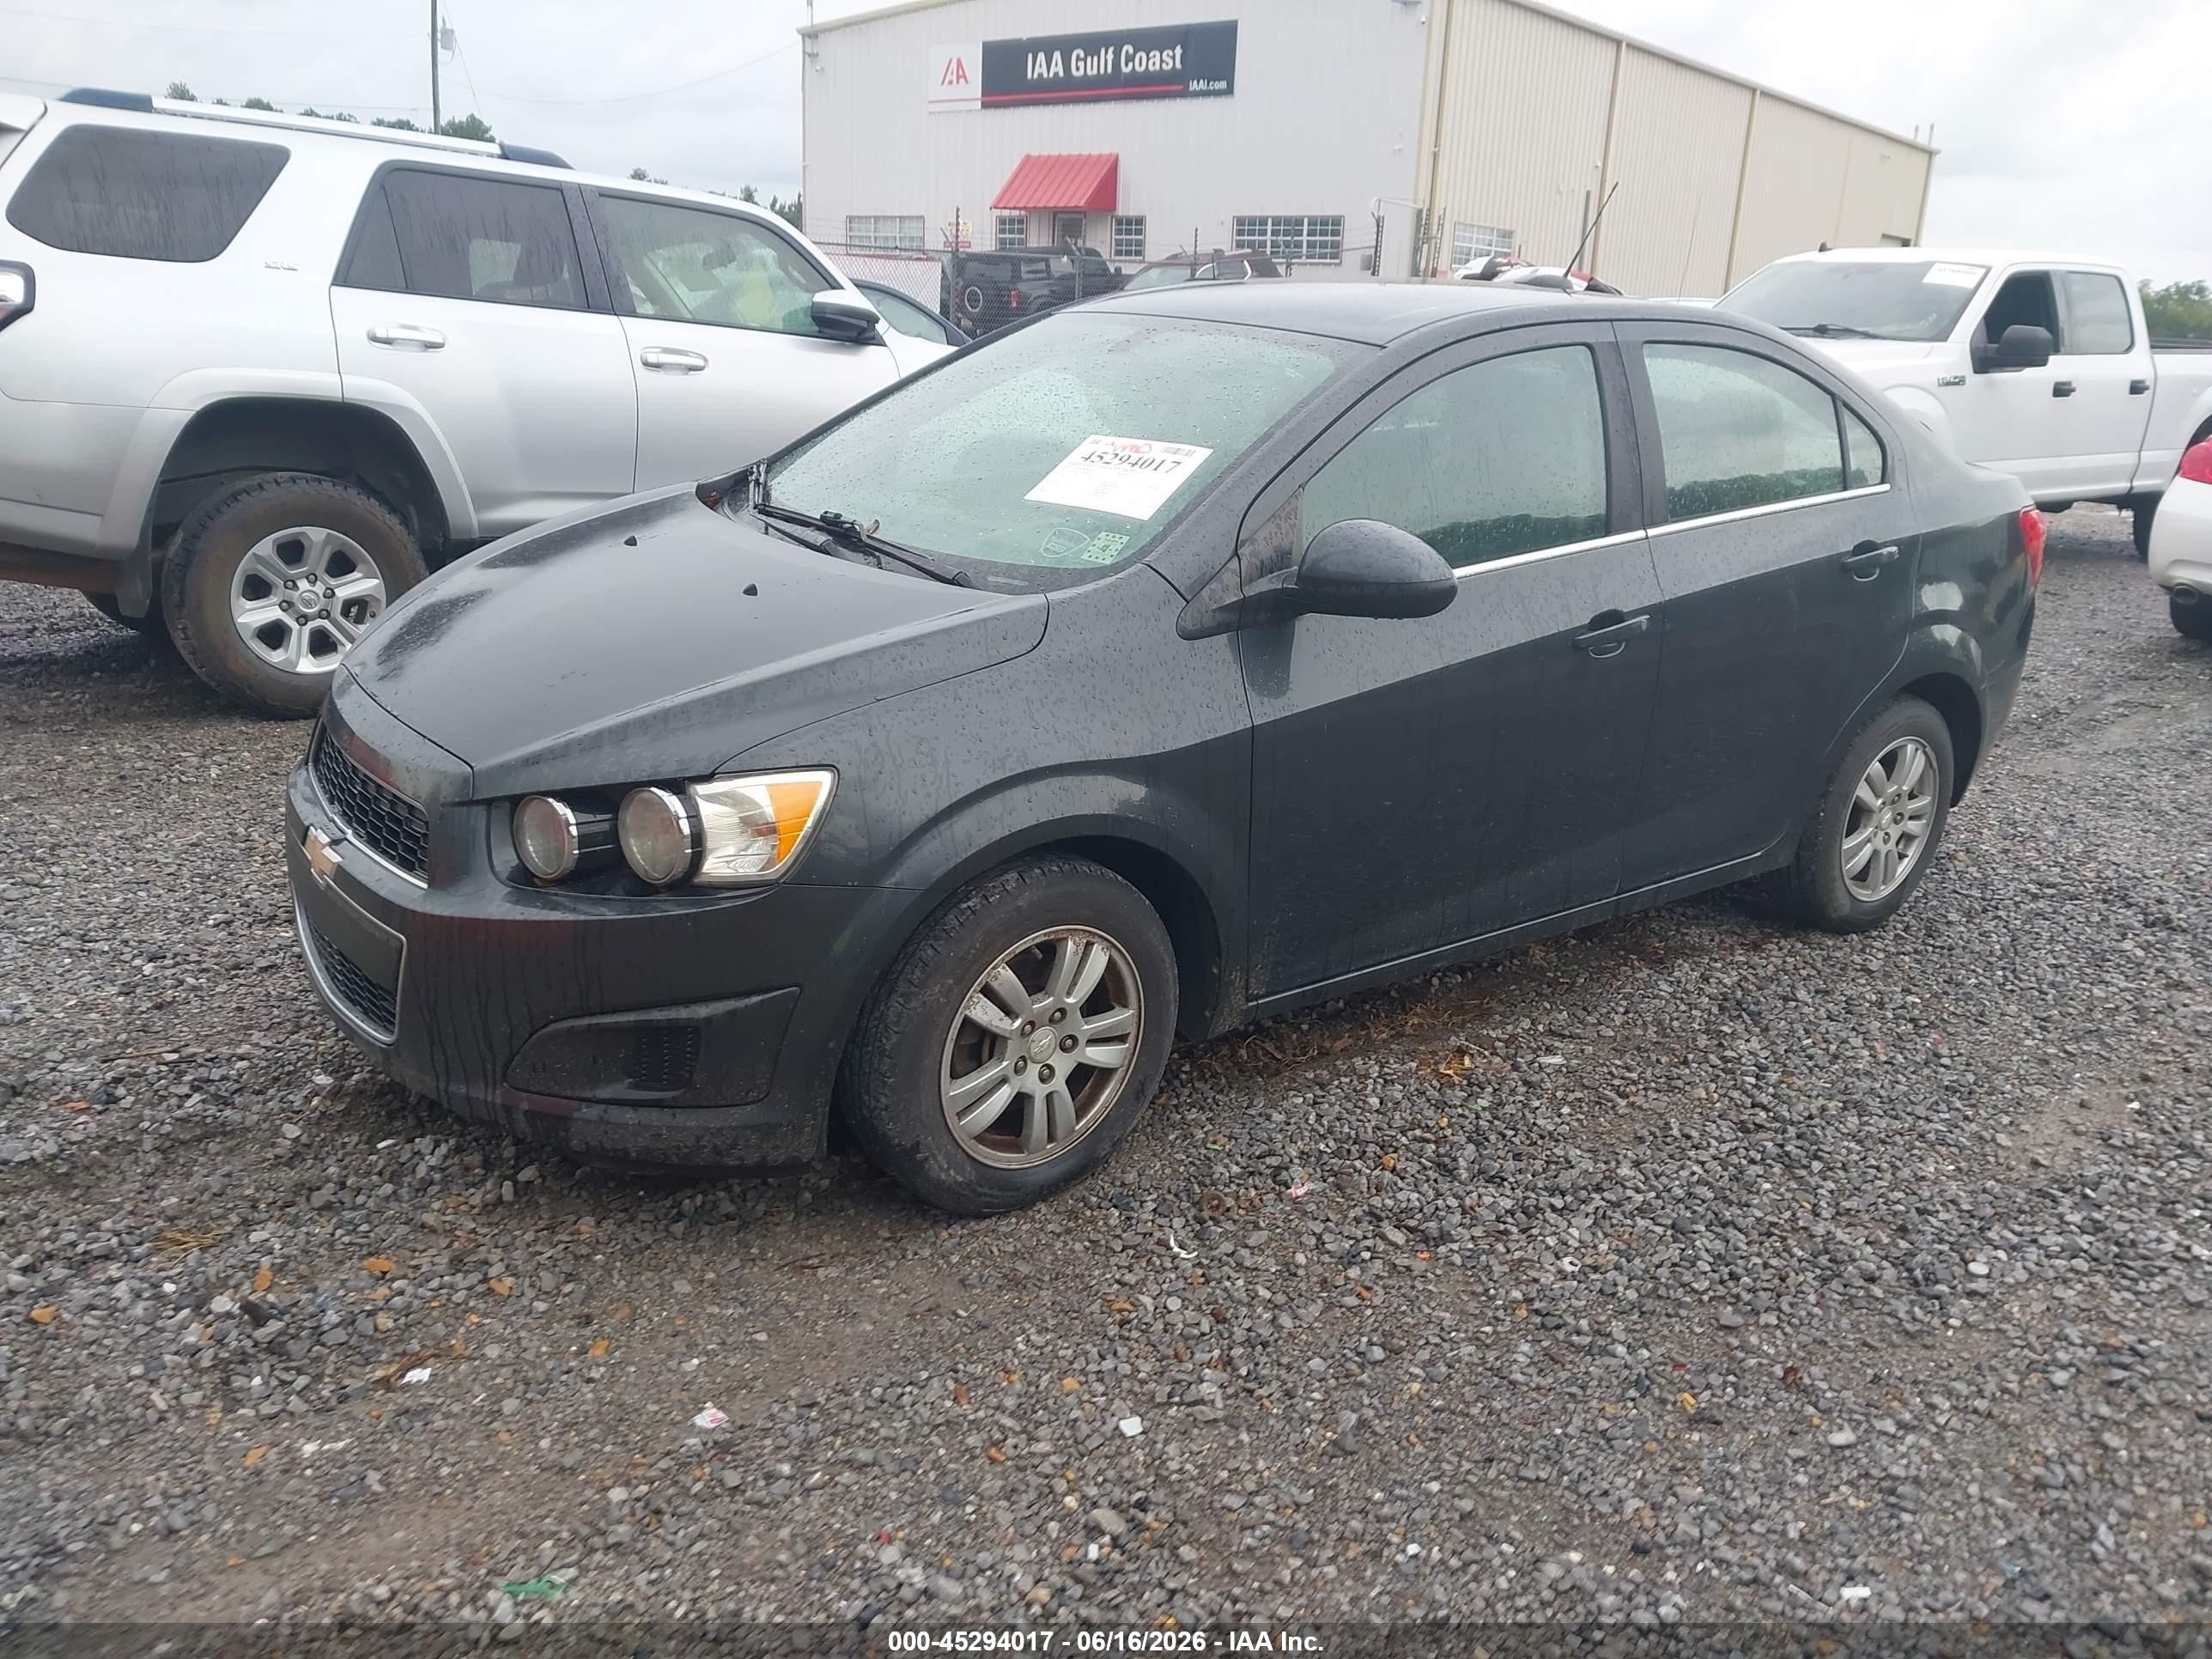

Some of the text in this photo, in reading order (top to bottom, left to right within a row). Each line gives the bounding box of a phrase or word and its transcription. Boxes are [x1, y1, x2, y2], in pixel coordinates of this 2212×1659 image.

[1026, 44, 1182, 80] IAA Gulf Coast
[1080, 450, 1182, 473] 45294017
